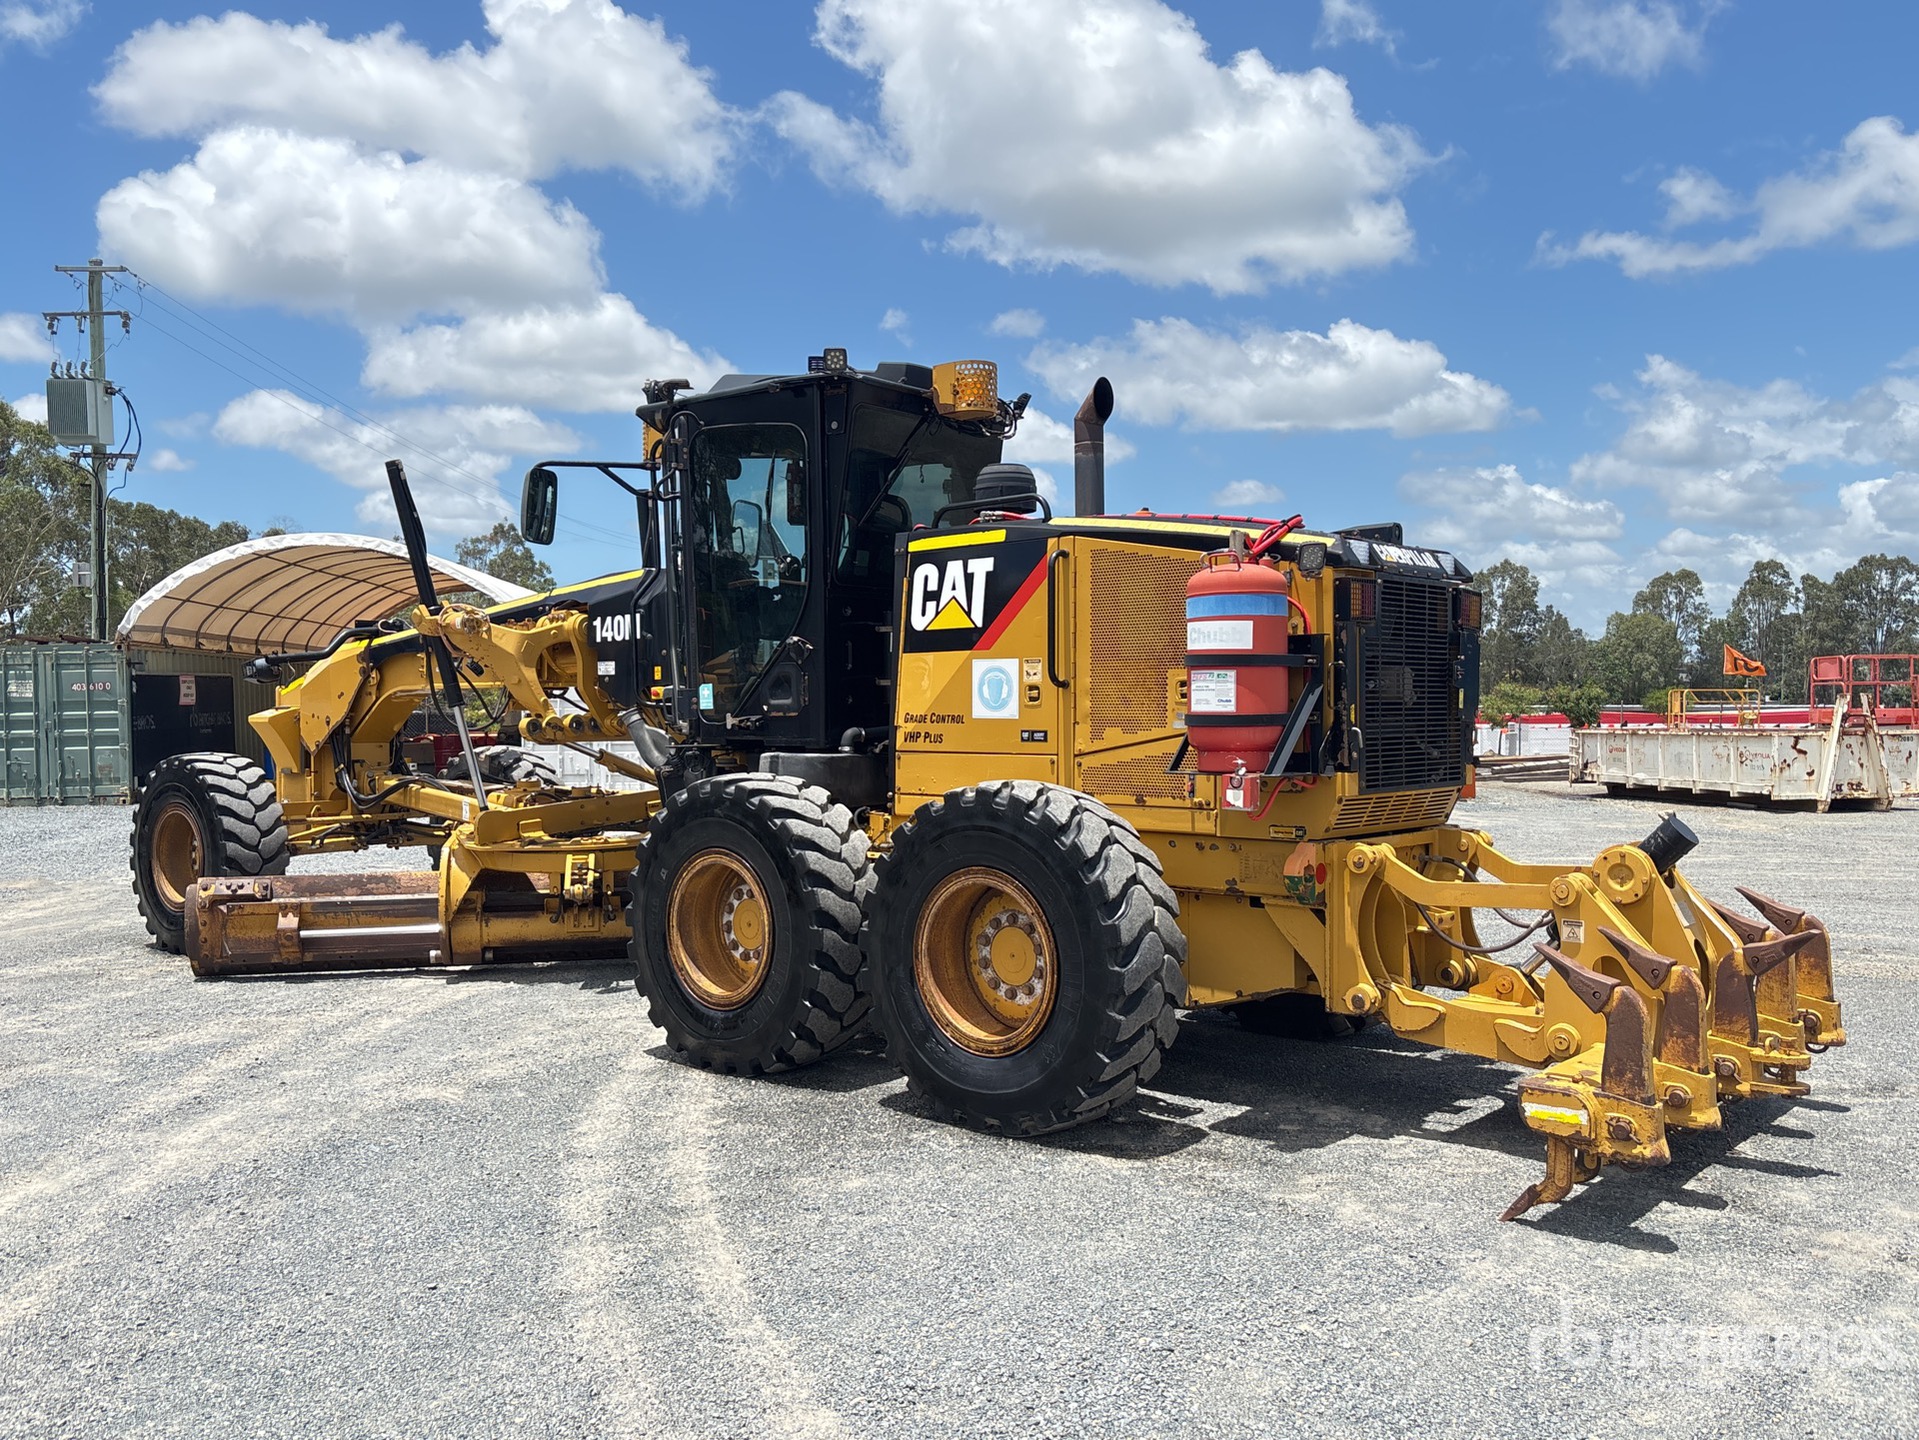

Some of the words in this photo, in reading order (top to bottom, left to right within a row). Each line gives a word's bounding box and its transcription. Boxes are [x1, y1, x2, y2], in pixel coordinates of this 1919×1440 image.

[910, 557, 995, 632] CAT
[1189, 627, 1246, 644] Chubb
[90, 683, 103, 691] 610
[904, 731, 921, 744] VHP
